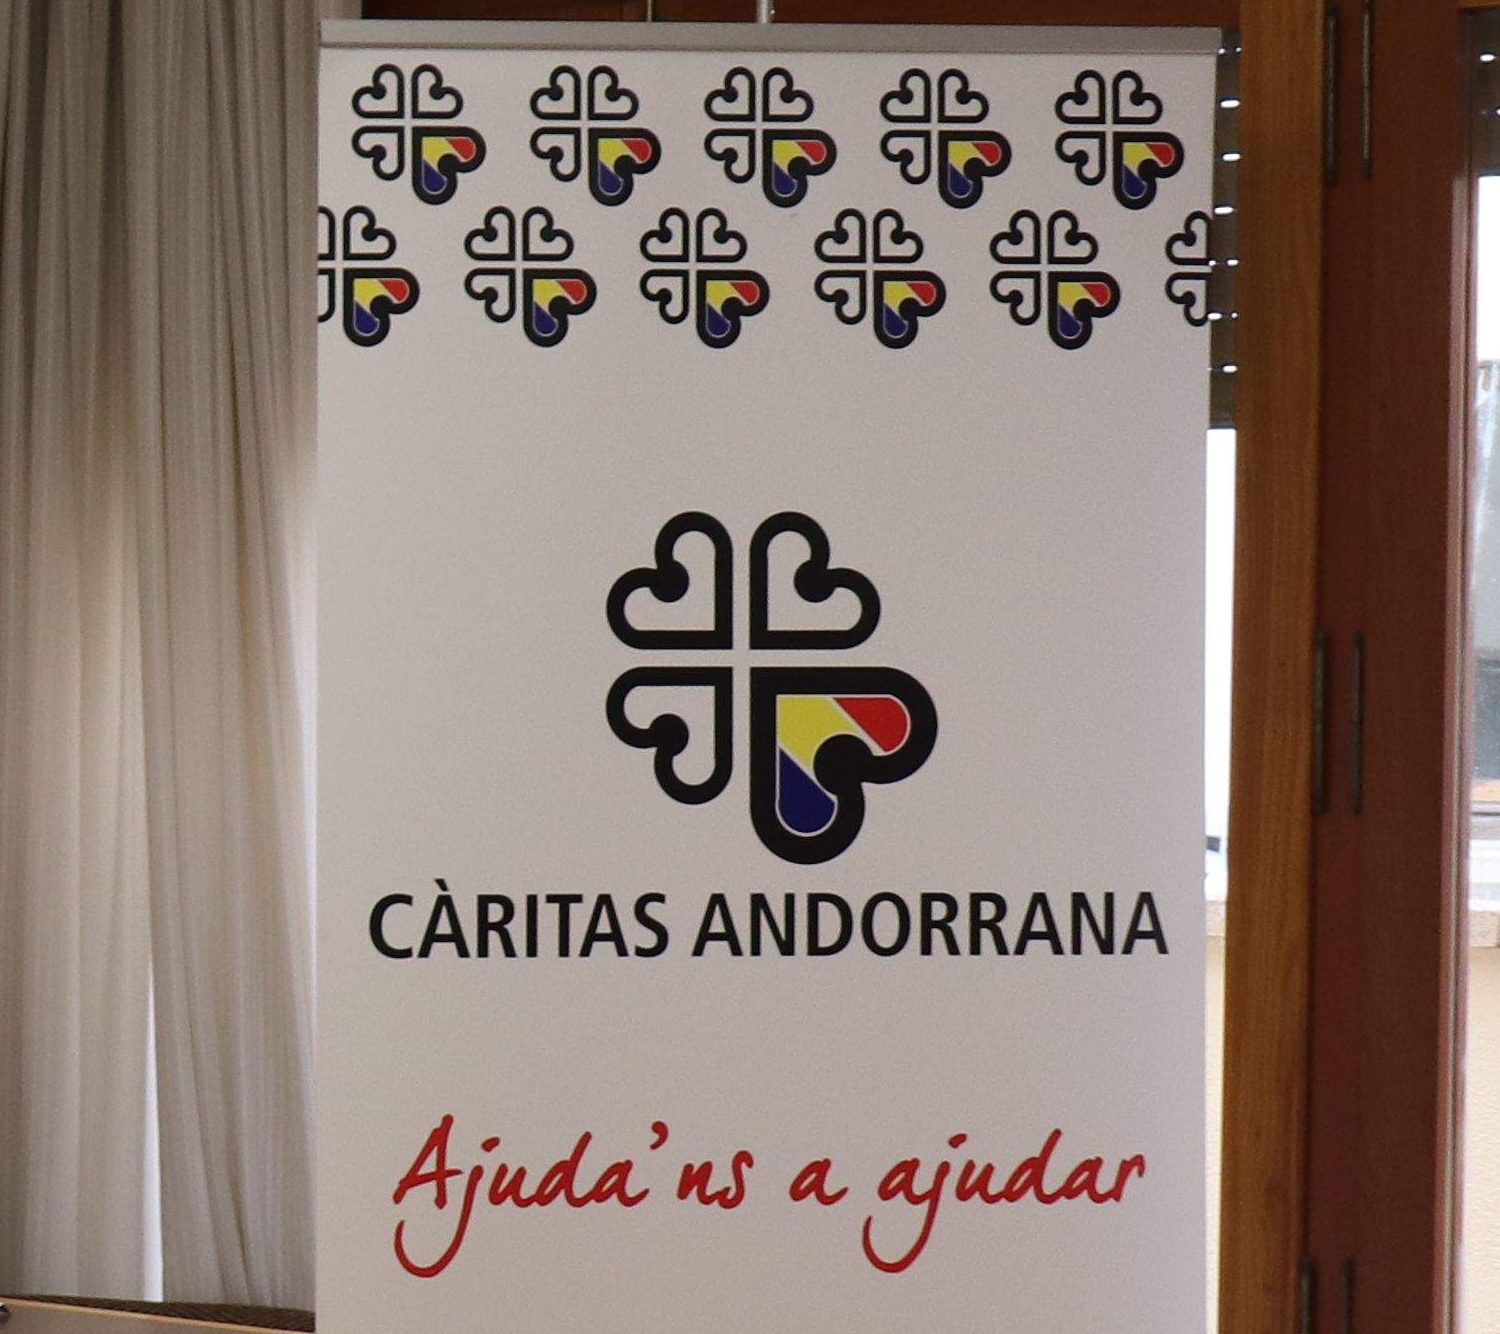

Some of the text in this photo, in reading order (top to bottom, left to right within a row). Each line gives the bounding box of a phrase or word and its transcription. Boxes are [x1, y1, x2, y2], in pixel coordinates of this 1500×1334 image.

[368, 878, 1170, 959] CÀRITAS ANDORRANA
[392, 1114, 1147, 1280] Ajuda'ns a ajudar
